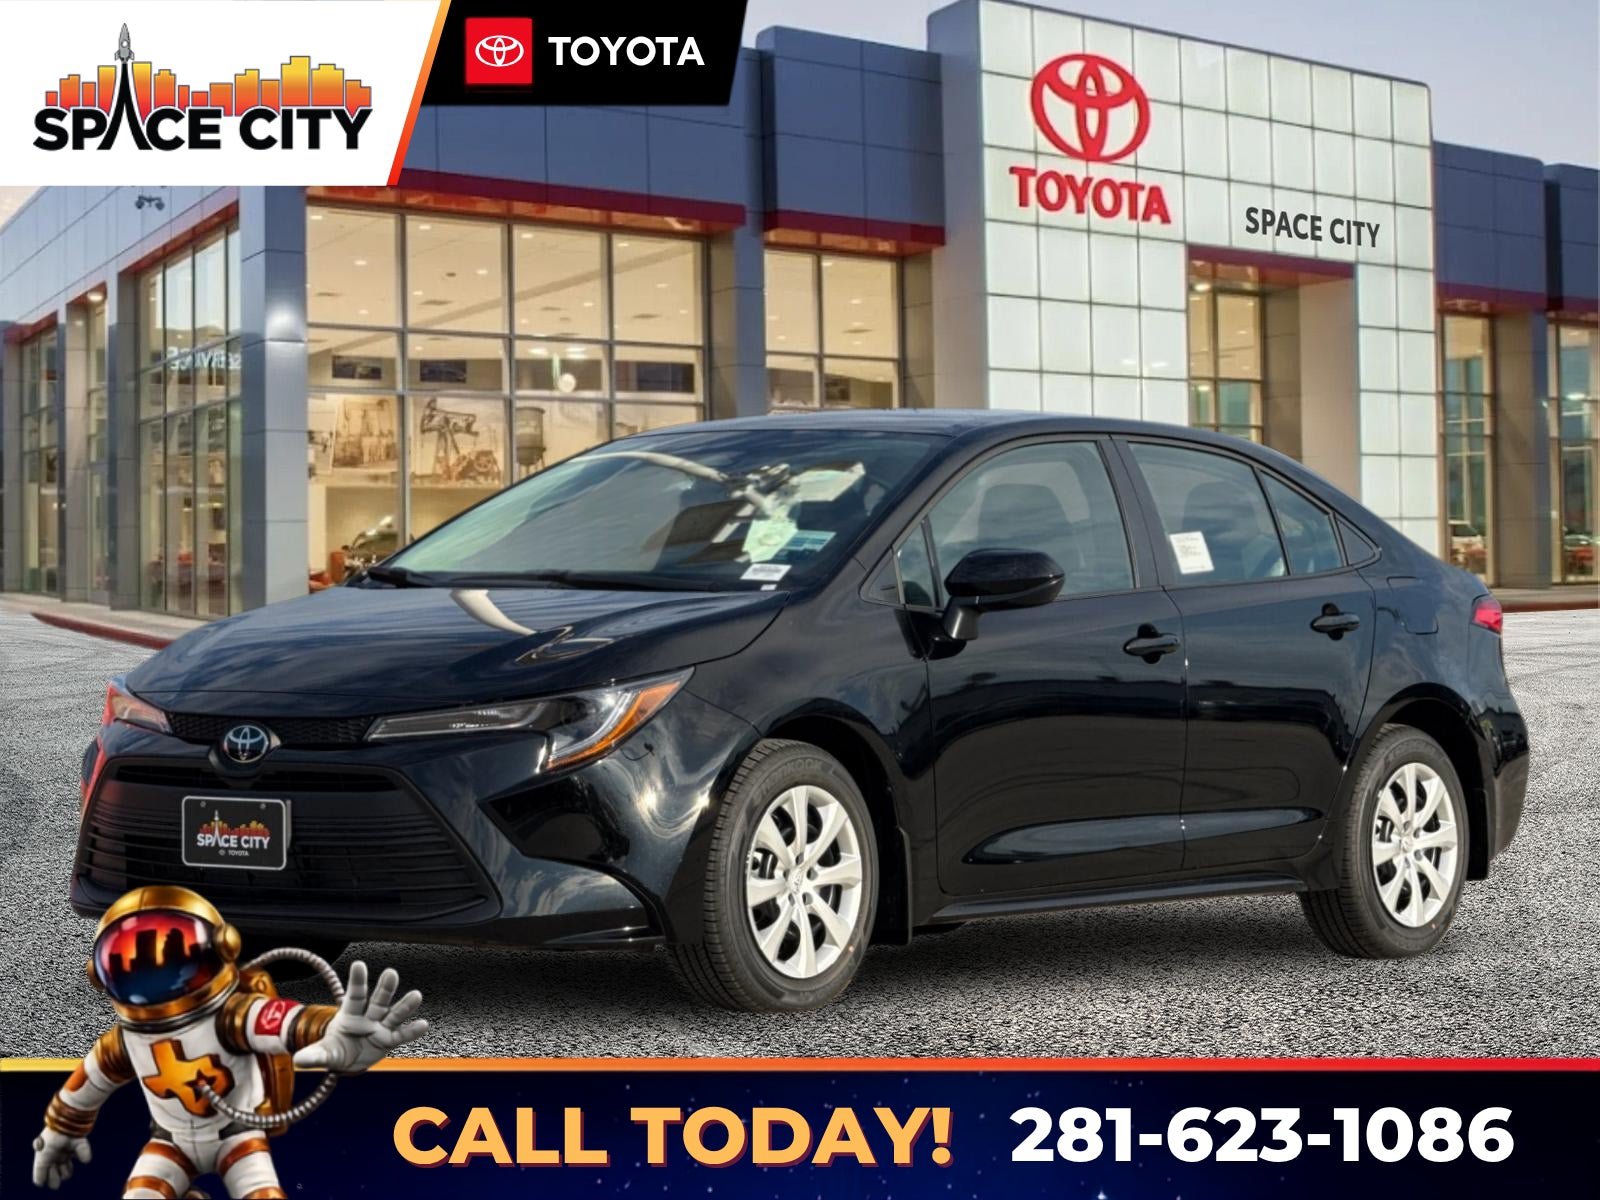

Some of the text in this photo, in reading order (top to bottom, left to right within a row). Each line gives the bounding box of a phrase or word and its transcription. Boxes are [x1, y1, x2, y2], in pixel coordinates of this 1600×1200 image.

[1009, 166, 1171, 224] TOYOTA
[1245, 206, 1380, 248] SPACE CITY
[196, 830, 270, 849] SPACE CITY
[228, 849, 250, 857] TOYOTA
